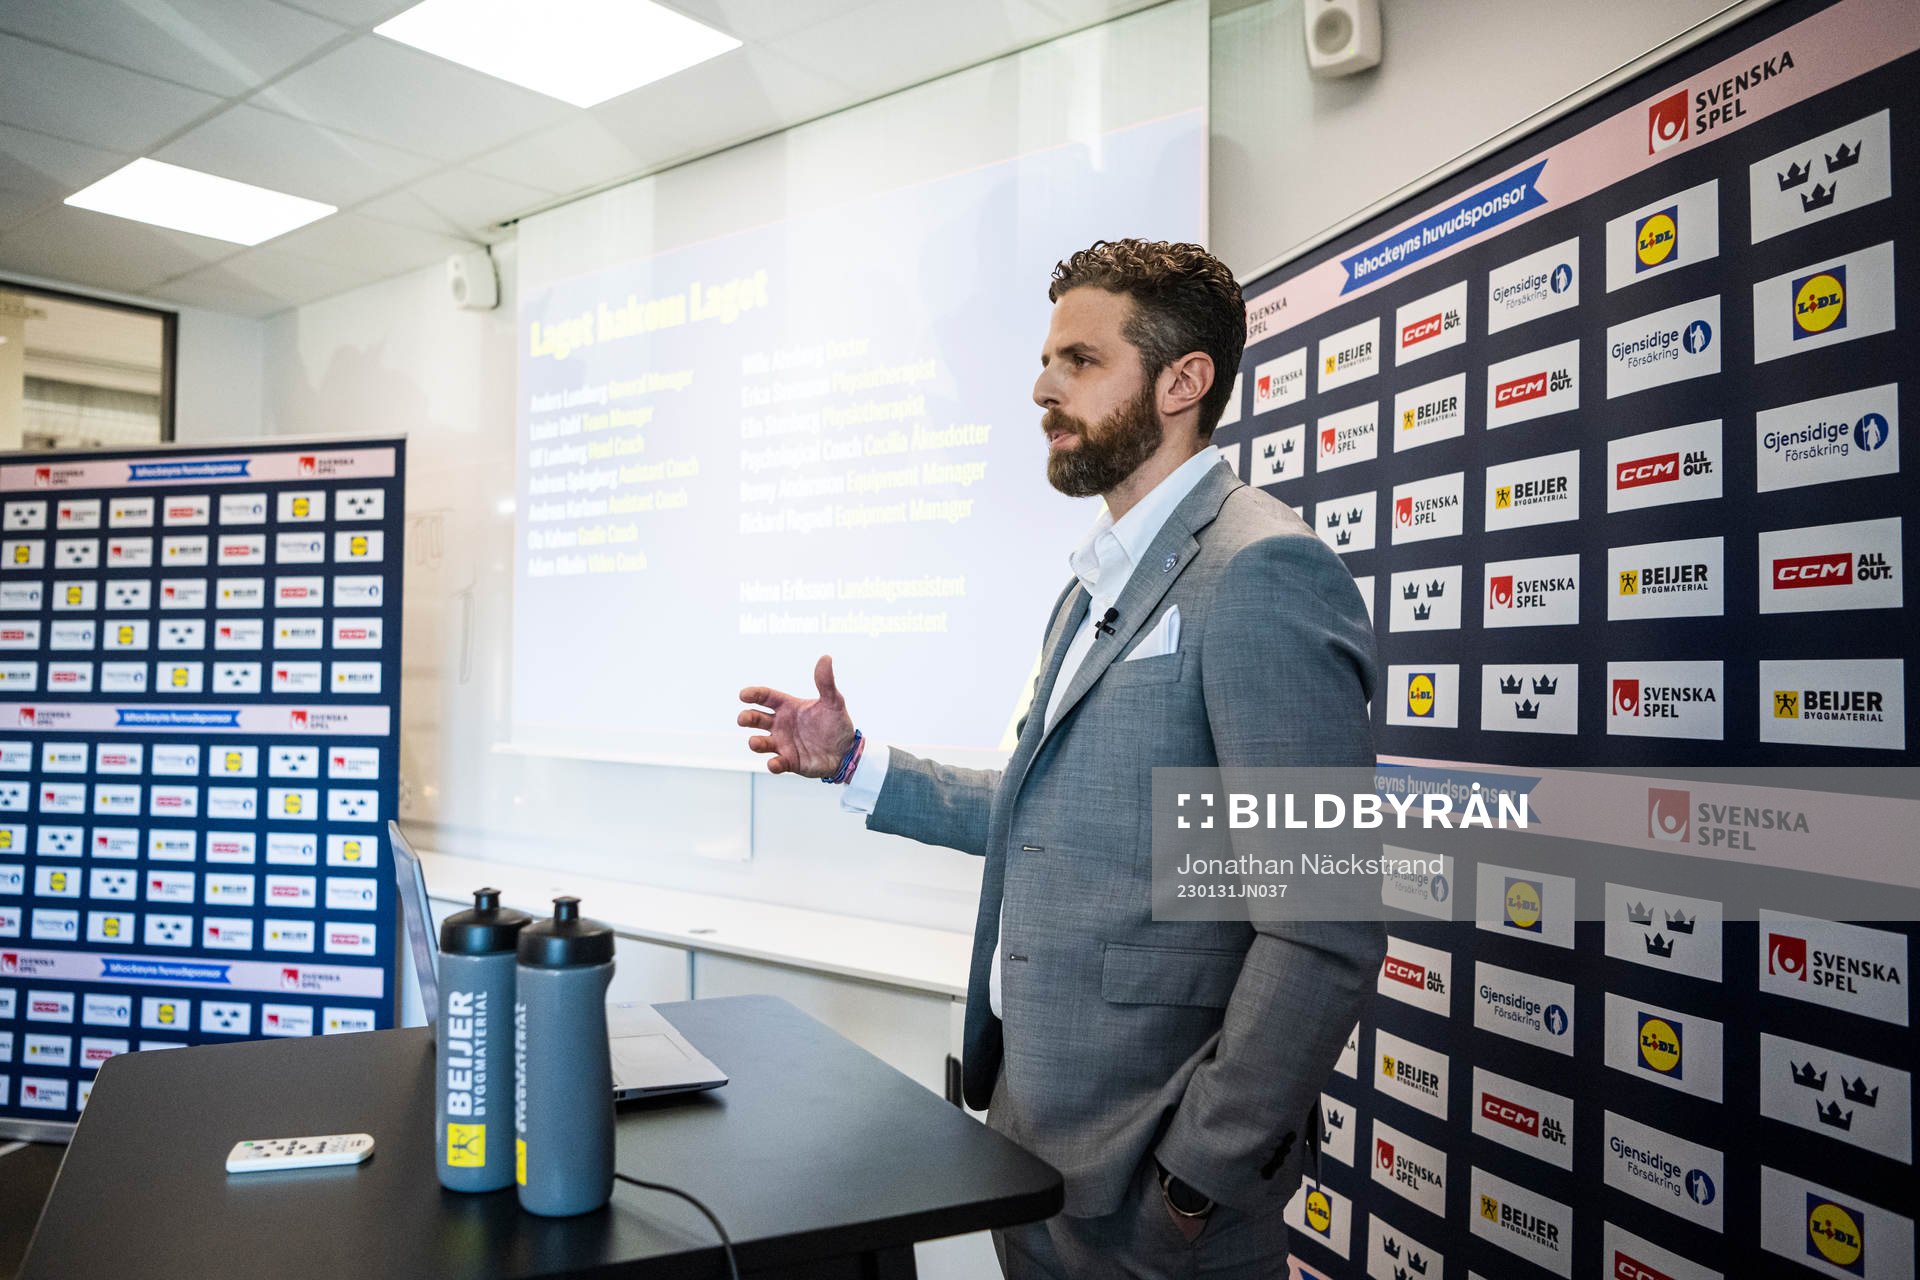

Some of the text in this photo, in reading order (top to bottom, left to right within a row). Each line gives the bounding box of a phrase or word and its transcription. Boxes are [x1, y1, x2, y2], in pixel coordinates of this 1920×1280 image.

[1694, 50, 1795, 114] SVENSKA
[1694, 98, 1747, 135] SPEL
[1353, 183, 1527, 279] Ishockeyns huvudsponsor
[1493, 272, 1548, 304] Gjensidige
[1505, 289, 1548, 310] Försäkring
[1249, 296, 1288, 325] SVENSKA
[1444, 309, 1458, 321] ALL
[1403, 319, 1440, 342] CCM
[1337, 341, 1373, 365] BEIJER
[1611, 328, 1679, 363] Gjensidige
[1628, 346, 1679, 369] Försäkring
[1271, 368, 1304, 387] SVENSKA
[1550, 368, 1569, 382] ALL
[1271, 385, 1289, 399] SPEL
[1497, 379, 1544, 402] CCM
[1417, 396, 1457, 420] BEIJER
[1337, 422, 1375, 442] SVENSKA
[1763, 421, 1849, 454] Gjensidige
[1337, 439, 1357, 454] SPEL
[1683, 450, 1708, 465] ALL
[1785, 441, 1849, 463] Försäkring
[1619, 459, 1675, 482] CCM
[1514, 476, 1568, 499] BEIJER
[1415, 494, 1459, 513] SVENSKA
[1514, 492, 1568, 507] BYGGMATERIAL
[1415, 511, 1436, 526] SPEL
[1777, 561, 1848, 581] CCM
[1858, 552, 1886, 567] ALL
[1516, 577, 1575, 594] SVENSKA
[1642, 563, 1708, 586] BEIJER
[1642, 582, 1708, 595] BYGGMATERIAL
[1516, 594, 1546, 609] SPEL
[1643, 686, 1717, 704] SVENSKA
[1803, 690, 1884, 713] BEIJER
[1643, 703, 1680, 718] SPEL
[1803, 711, 1884, 722] BYGGMATERIAL
[1697, 802, 1810, 834] SVENSKA
[1697, 826, 1757, 852] SPEL
[1386, 962, 1423, 982] CCM
[1427, 970, 1442, 983] ALL
[1813, 950, 1901, 985] SVENSKA
[1813, 968, 1858, 994] SPEL
[1480, 985, 1541, 1016] Gjensidige
[1494, 1005, 1541, 1031] Försäkring
[447, 991, 473, 1116] BEIJER
[474, 991, 488, 1116] BYGGMATERIAL
[1397, 1060, 1440, 1091] BEIJER
[1485, 1101, 1536, 1128] CCM
[1542, 1116, 1563, 1132] ALL
[1609, 1136, 1682, 1178] Gjensidige
[1396, 1154, 1443, 1188] SVENSKA
[1396, 1168, 1420, 1191] SPEL
[1627, 1161, 1681, 1197] Försäkring
[1501, 1202, 1560, 1244] BEIJER
[1501, 1220, 1560, 1252] BYGGMATERIAL
